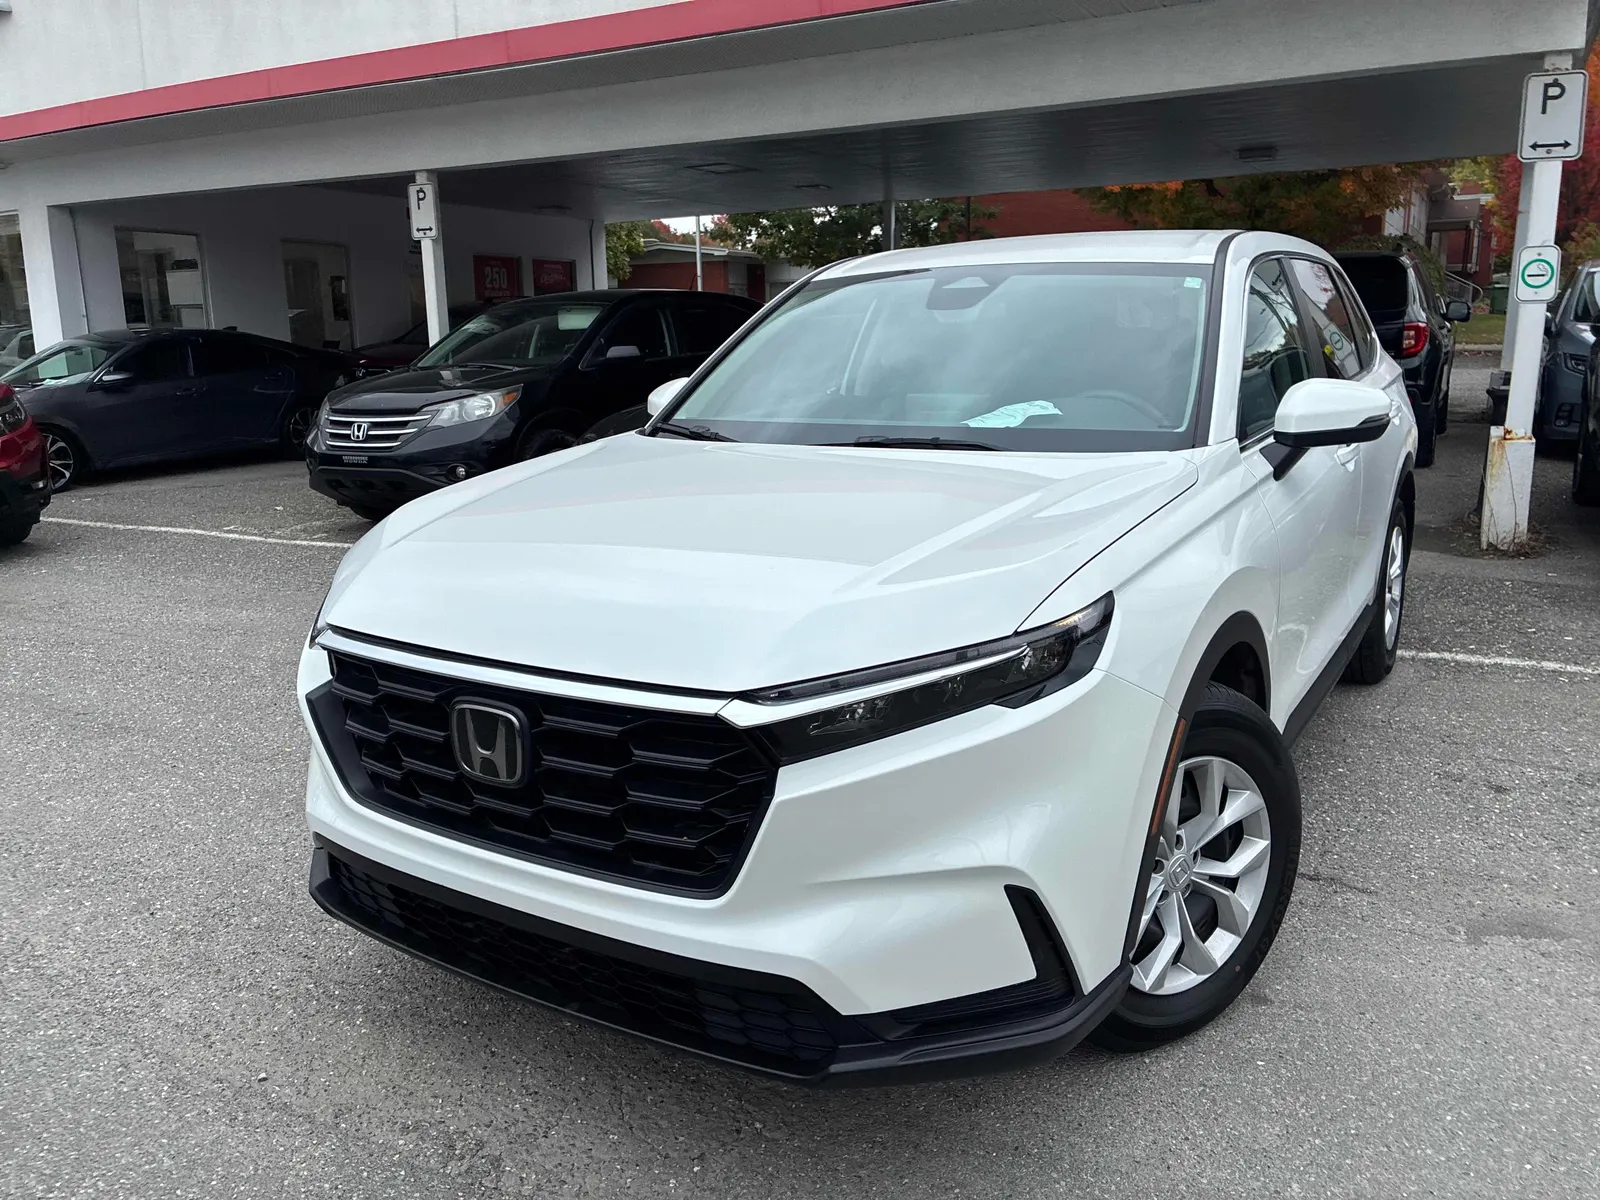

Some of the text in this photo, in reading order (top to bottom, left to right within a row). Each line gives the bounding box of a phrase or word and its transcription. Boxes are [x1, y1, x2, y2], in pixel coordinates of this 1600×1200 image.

[1541, 82, 1566, 114] P
[416, 189, 426, 210] P
[485, 266, 508, 288] 250
